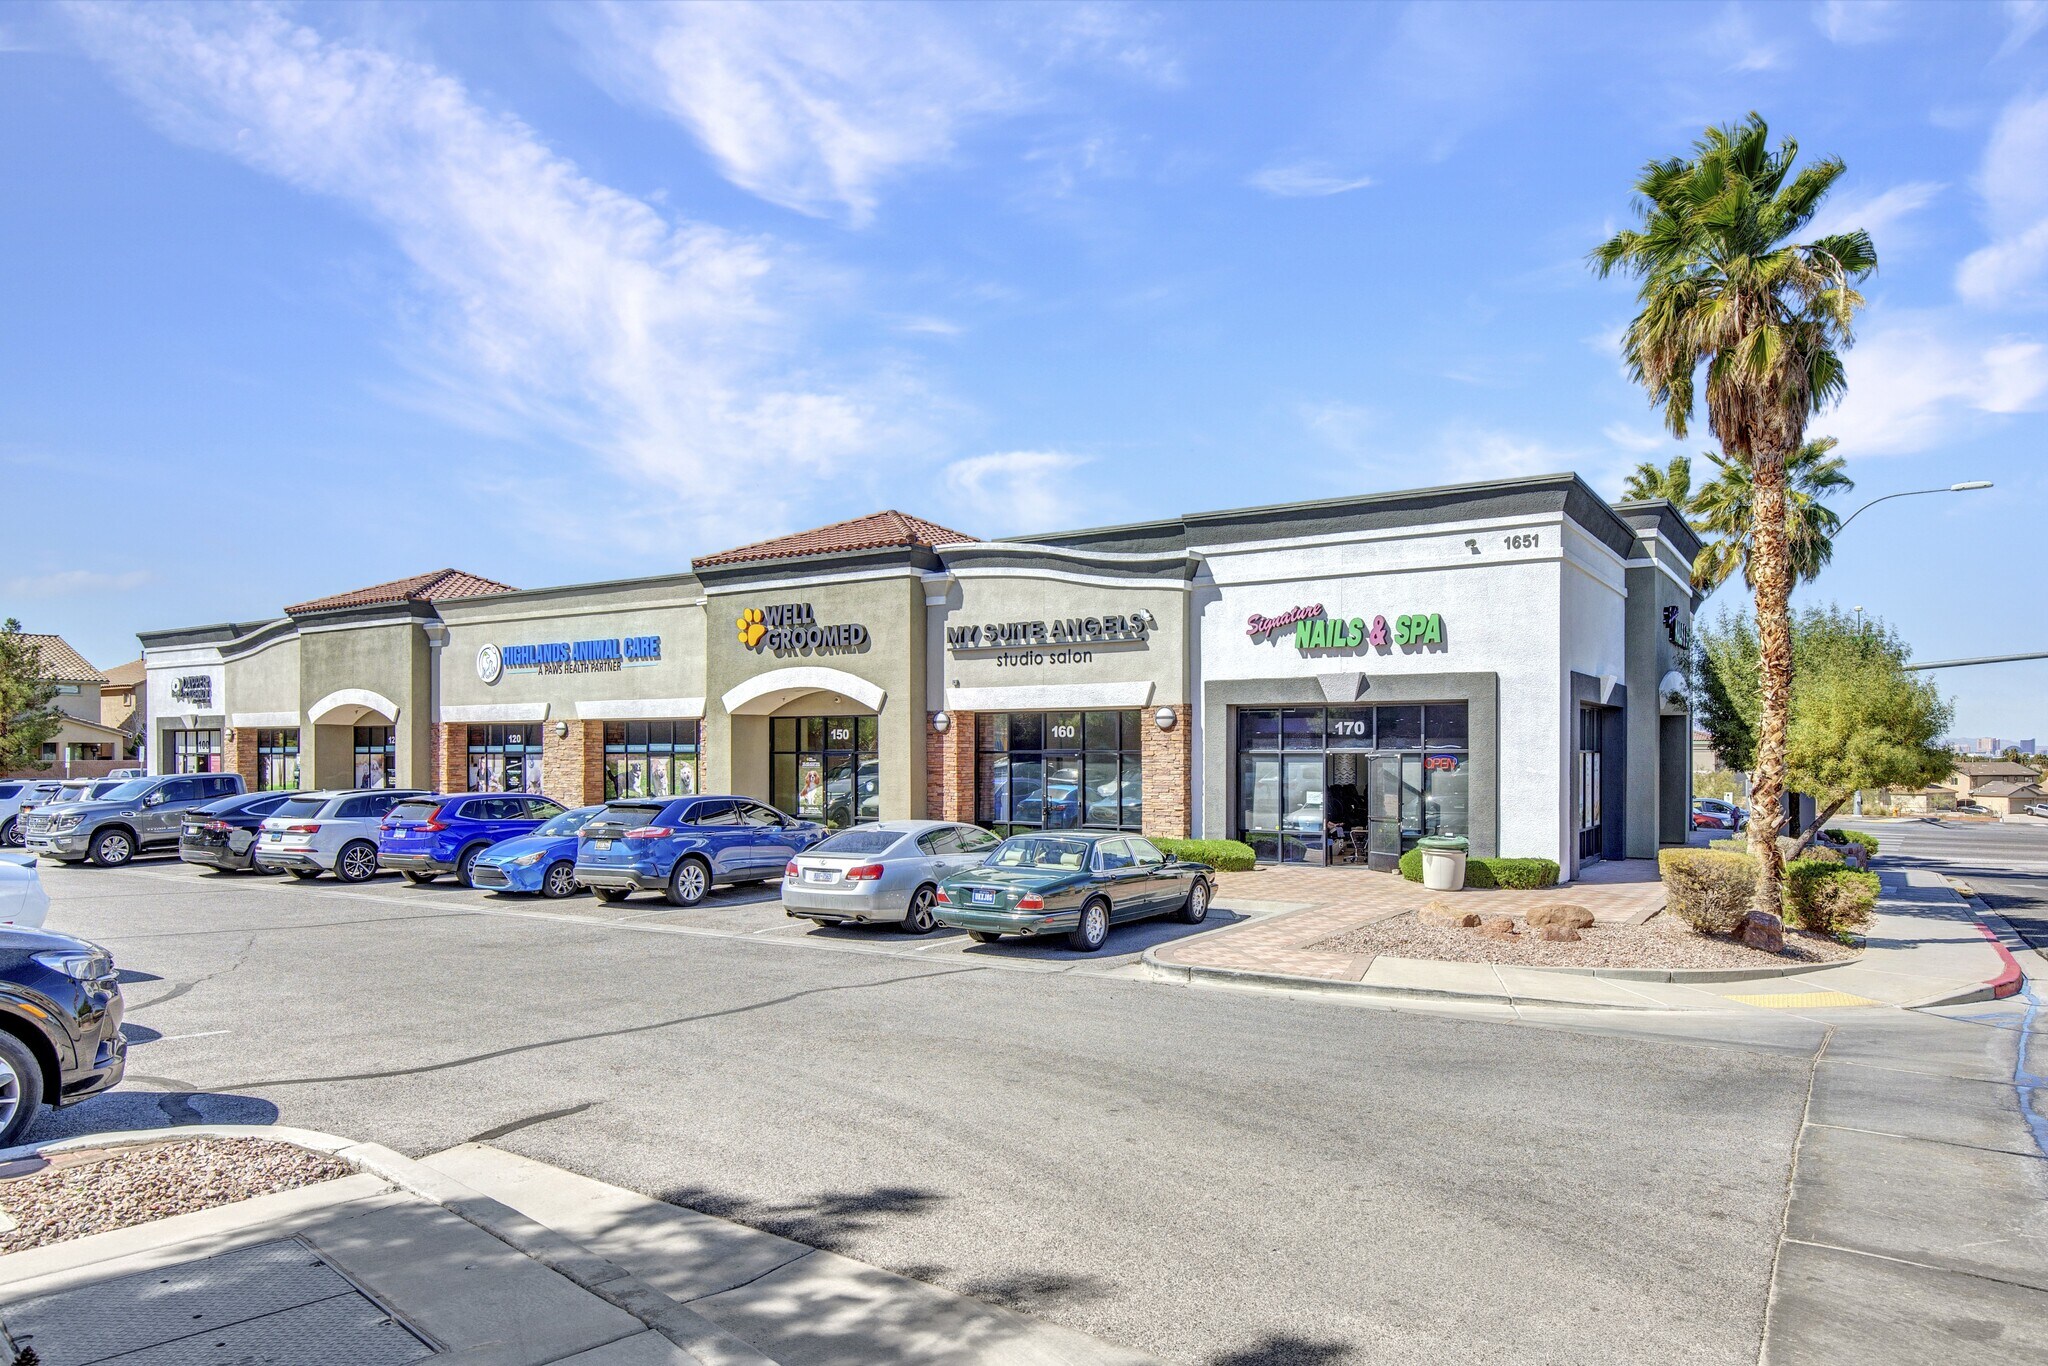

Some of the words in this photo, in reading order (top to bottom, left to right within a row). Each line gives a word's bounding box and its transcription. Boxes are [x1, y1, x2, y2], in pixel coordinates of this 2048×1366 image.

[1503, 533, 1539, 550] 1651
[764, 603, 813, 626] WELL
[1245, 602, 1323, 637] Signature
[946, 625, 978, 643] MY
[984, 620, 1045, 642] SUITE
[1050, 613, 1146, 638] ANGELS
[1295, 617, 1364, 649] NAILS
[1369, 614, 1388, 647] &
[1394, 613, 1442, 646] SPA
[766, 624, 868, 650] GROOMED
[502, 642, 571, 665] HIGHLANDS
[572, 638, 621, 661] ANIMAL
[623, 636, 661, 658] CARE
[996, 650, 1044, 667] studio
[1049, 648, 1093, 664] salon
[537, 666, 543, 676] A
[544, 665, 563, 675] PAWS
[564, 663, 589, 674] HEALTH
[591, 661, 622, 673] PARTNER
[830, 728, 850, 740] 150
[1051, 725, 1075, 738] 160
[1334, 721, 1366, 735] 170
[198, 740, 210, 750] 100
[508, 734, 522, 743] 120
[1424, 757, 1456, 770] OPEN
